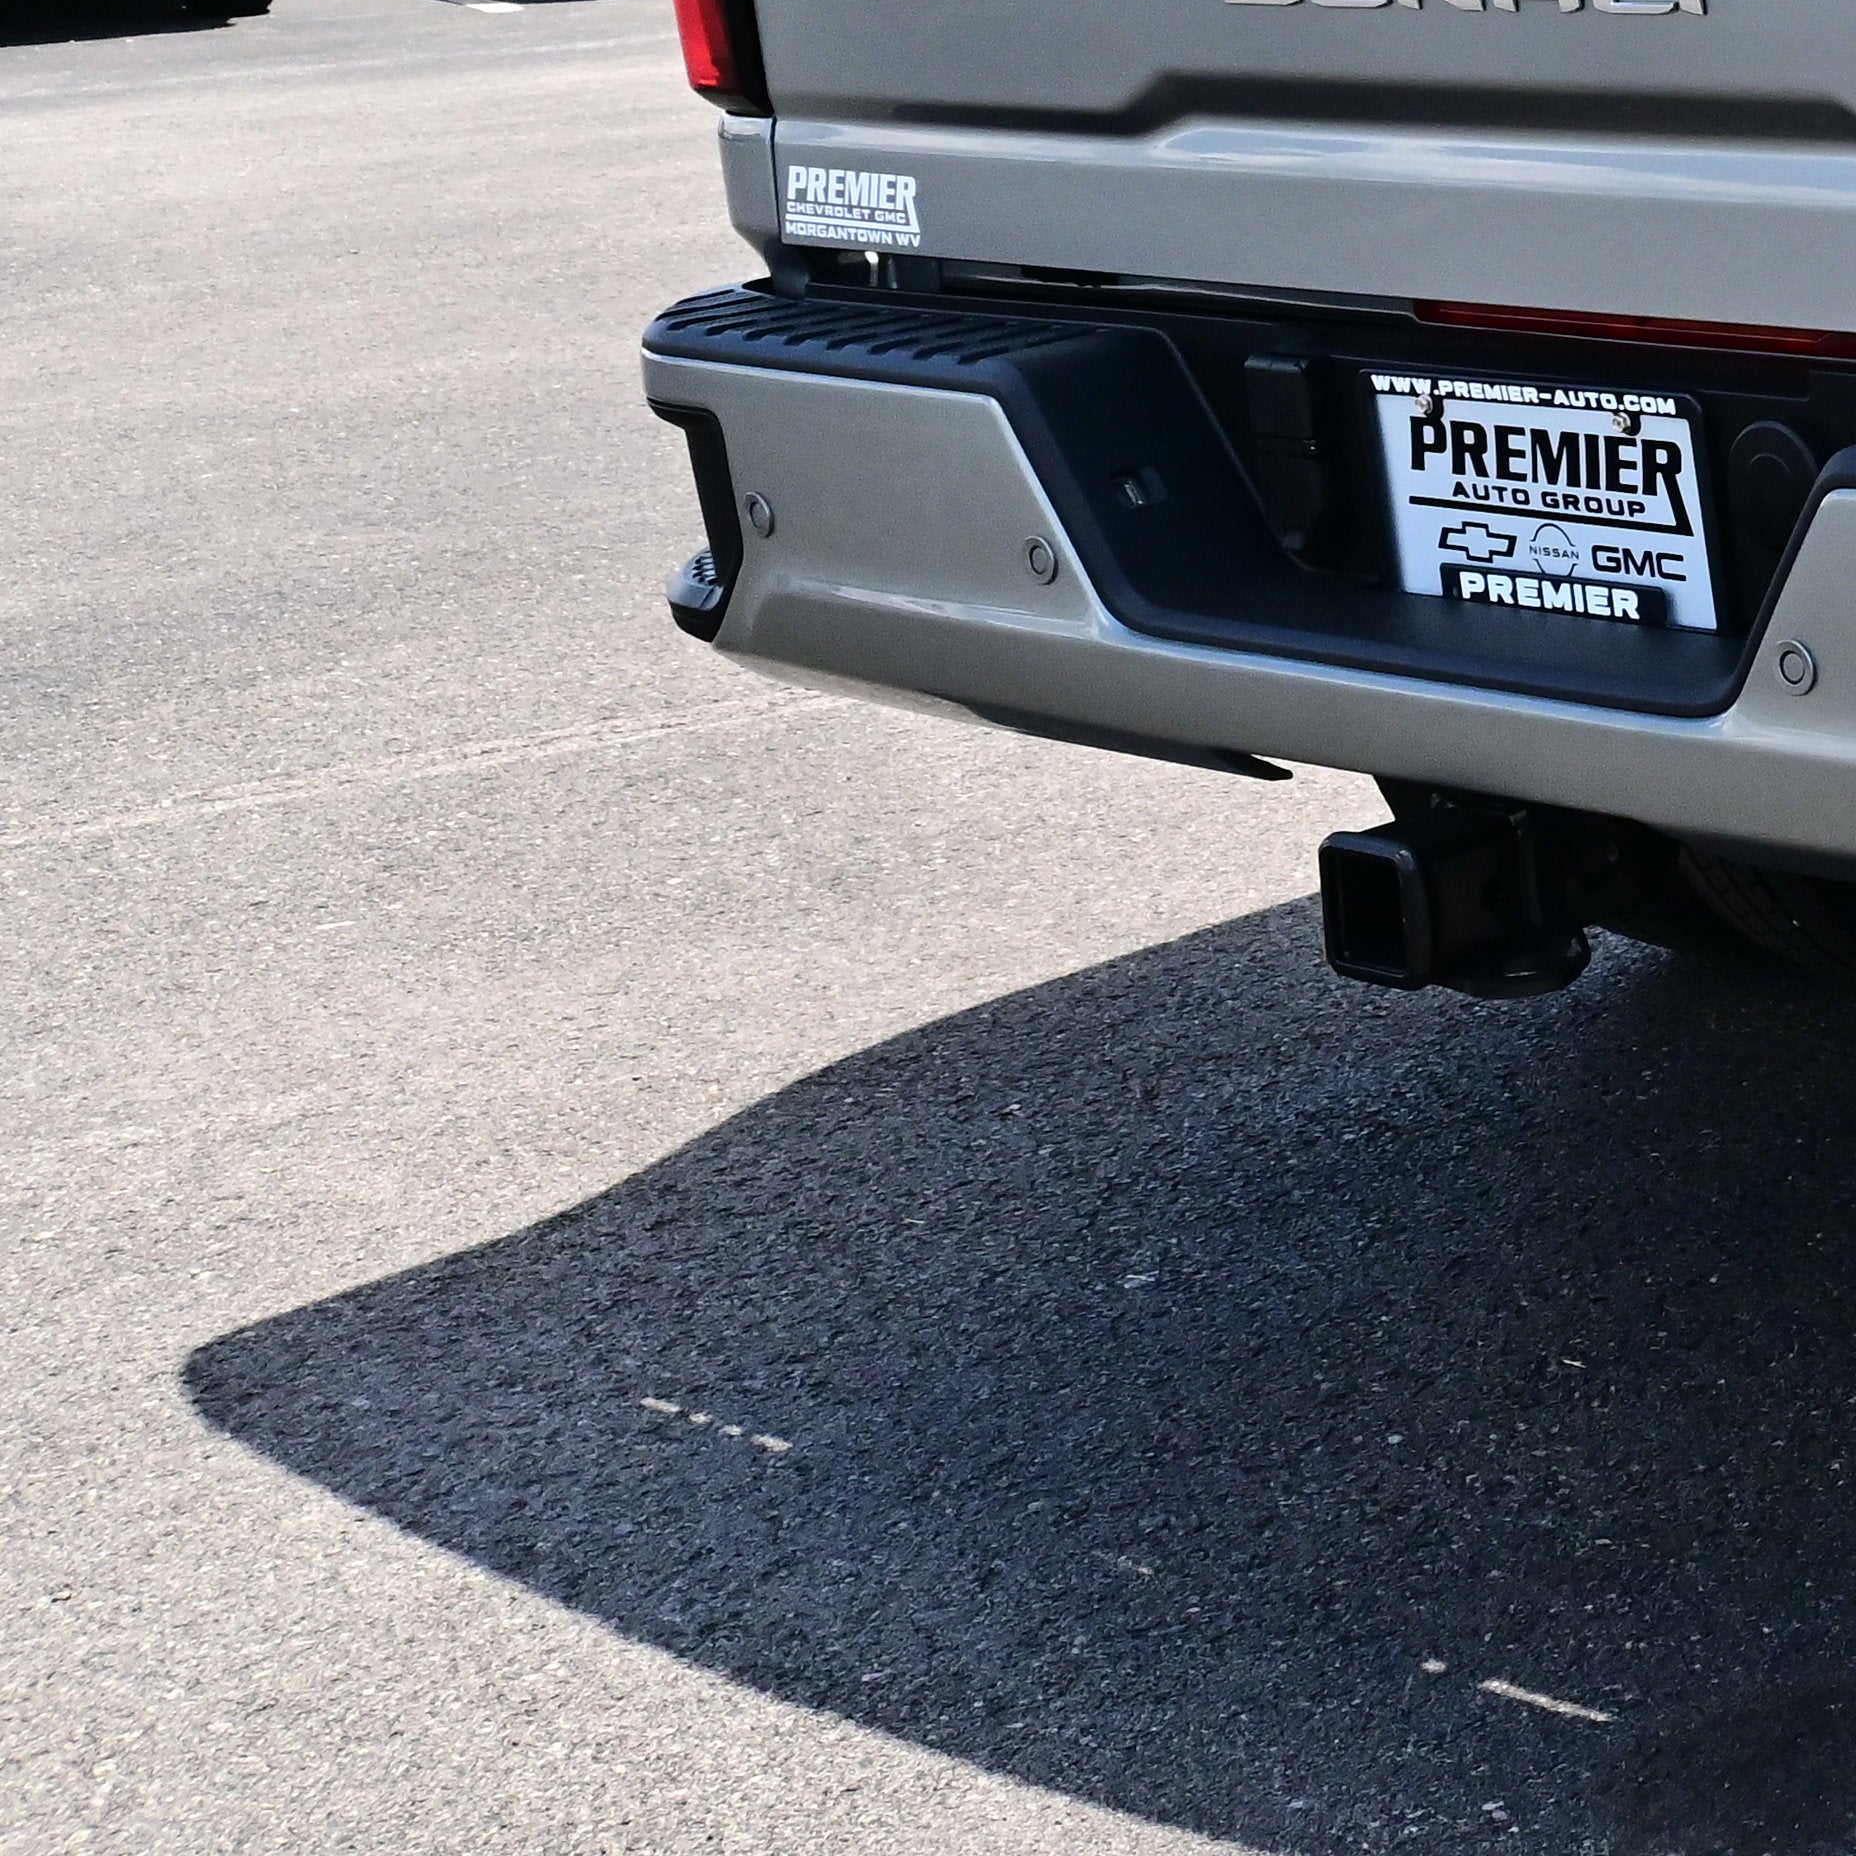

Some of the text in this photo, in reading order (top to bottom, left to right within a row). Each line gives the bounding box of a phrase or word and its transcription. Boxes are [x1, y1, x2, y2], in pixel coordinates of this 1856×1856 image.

[787, 165, 918, 217] PREMIER
[786, 201, 906, 224] CHEVROLET GMC
[785, 221, 921, 248] MORGANTOWN WV
[1370, 374, 1676, 416] WWW.PREMIER-AUTO.COM
[1409, 414, 1688, 509] PREMIER
[1452, 480, 1646, 518] AUTO GROUP
[1529, 544, 1580, 561] NISSAN
[1591, 544, 1687, 582] GMC
[1460, 571, 1640, 620] PREMIER
